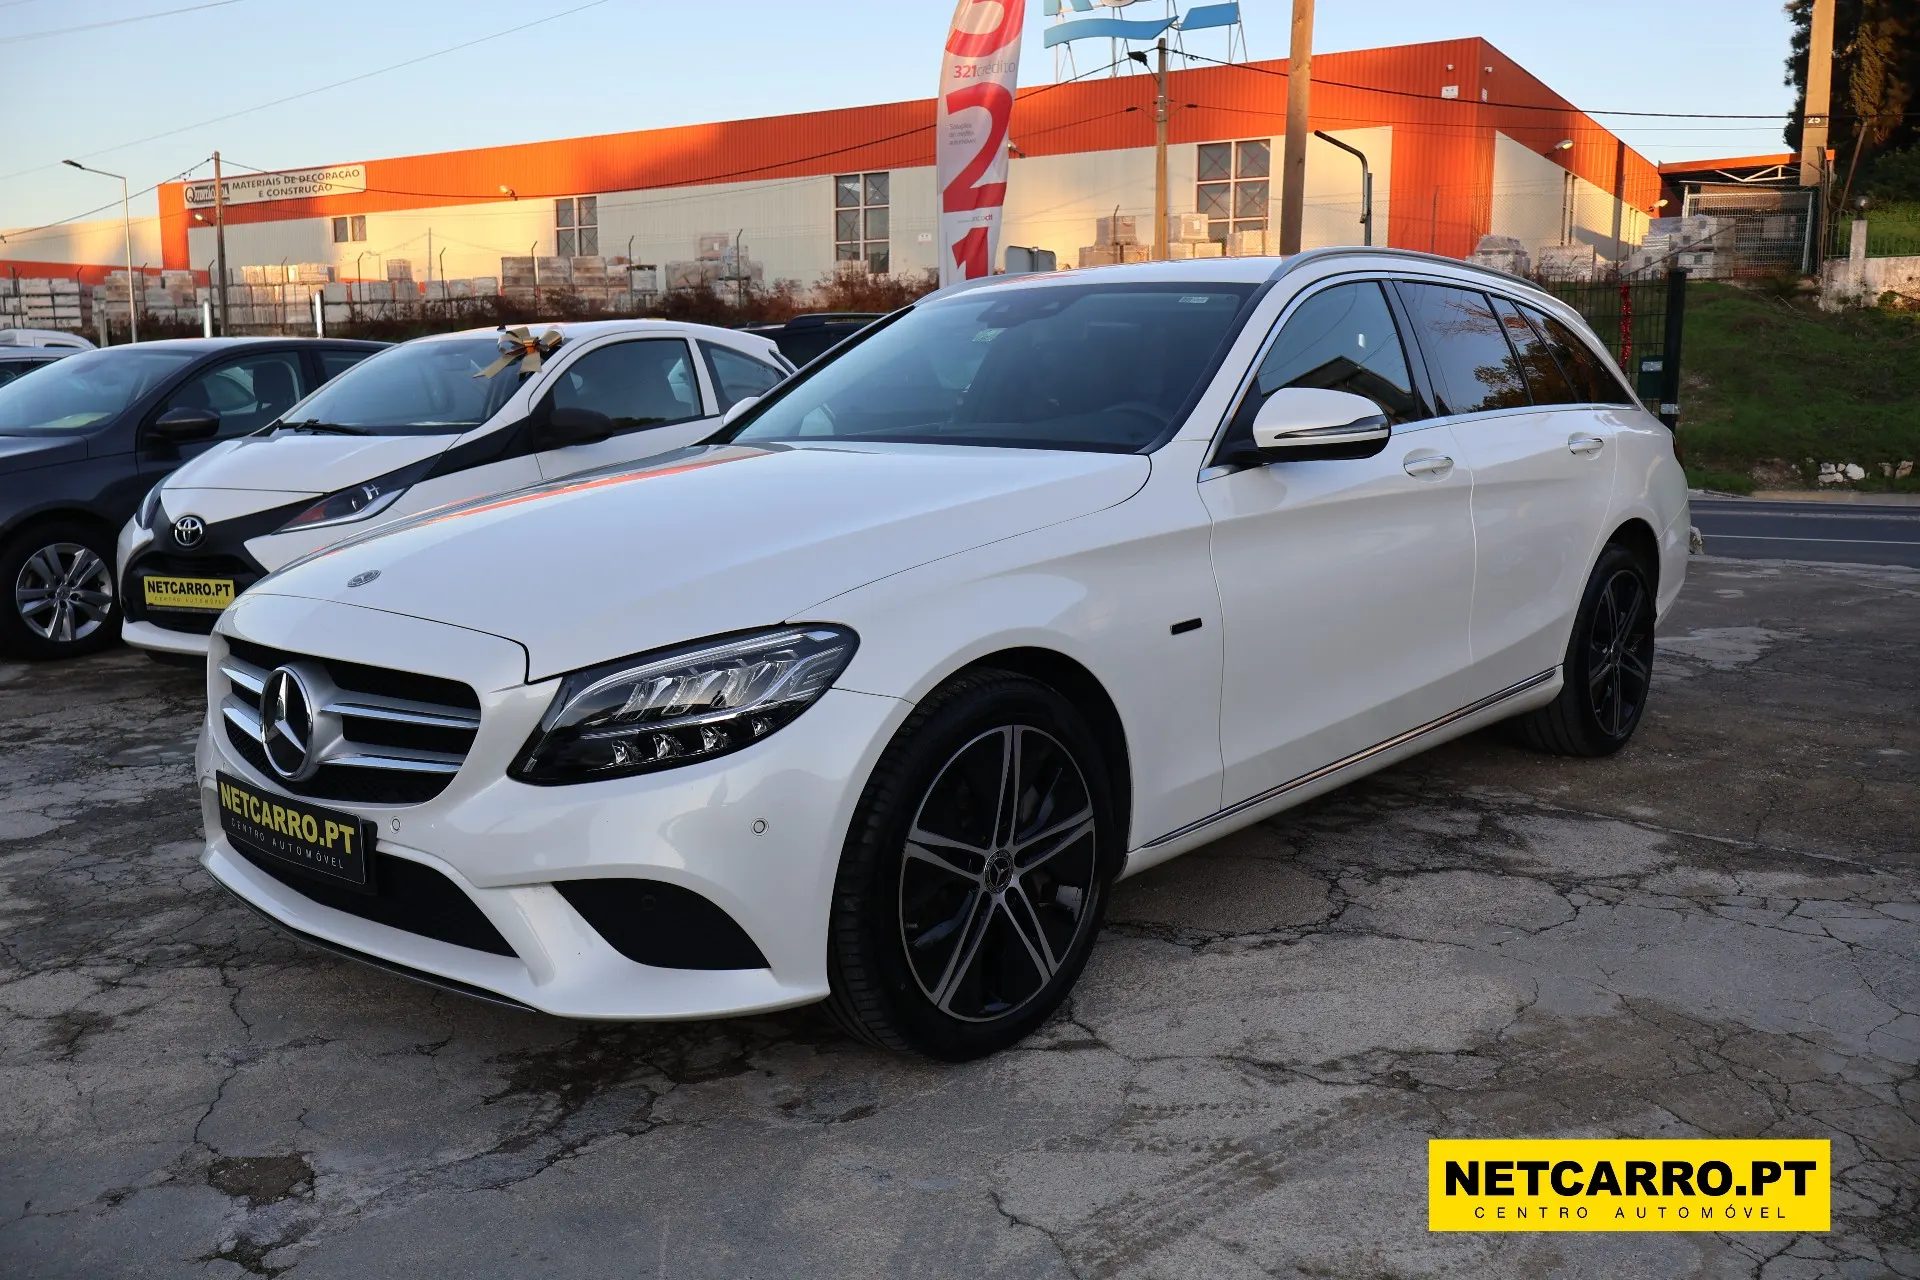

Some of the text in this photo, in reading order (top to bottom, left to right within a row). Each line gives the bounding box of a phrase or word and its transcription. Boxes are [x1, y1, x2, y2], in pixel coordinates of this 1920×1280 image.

[943, 82, 1013, 213] 2
[232, 168, 360, 190] MATERIAIS DE DECORAÇÃO
[259, 183, 333, 198] E CONSTRUÇÃO
[147, 581, 230, 597] NETCARRO.PT
[220, 782, 355, 855] NETCARRO.PT
[231, 817, 344, 870] CENTRO AUTOMÓVEL
